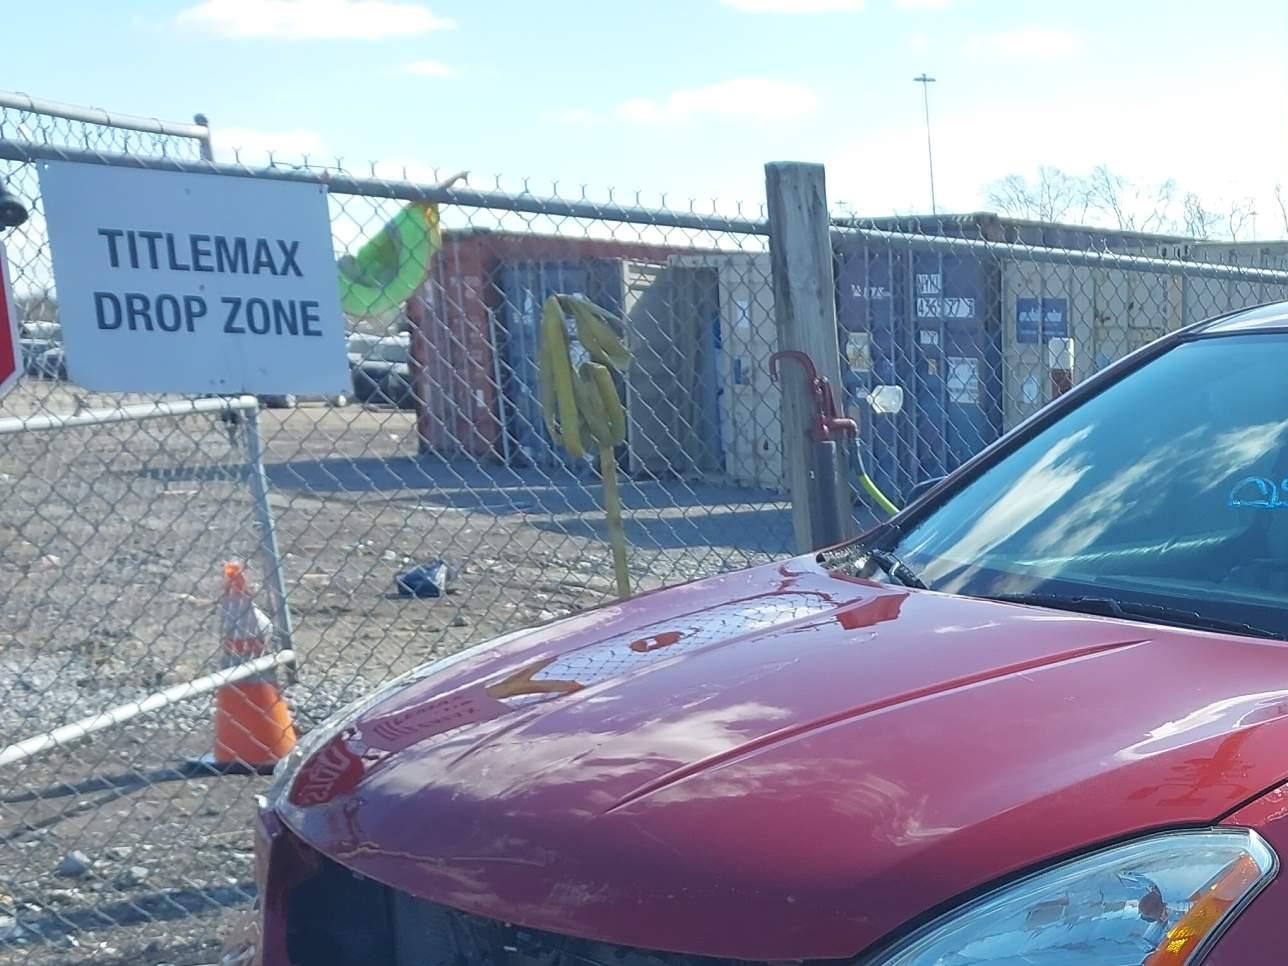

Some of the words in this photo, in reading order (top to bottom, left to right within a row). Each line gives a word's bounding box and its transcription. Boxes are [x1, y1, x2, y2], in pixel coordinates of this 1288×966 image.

[97, 227, 304, 277] TITLEMAX
[93, 291, 208, 332] DROP
[220, 296, 323, 337] ZONE
